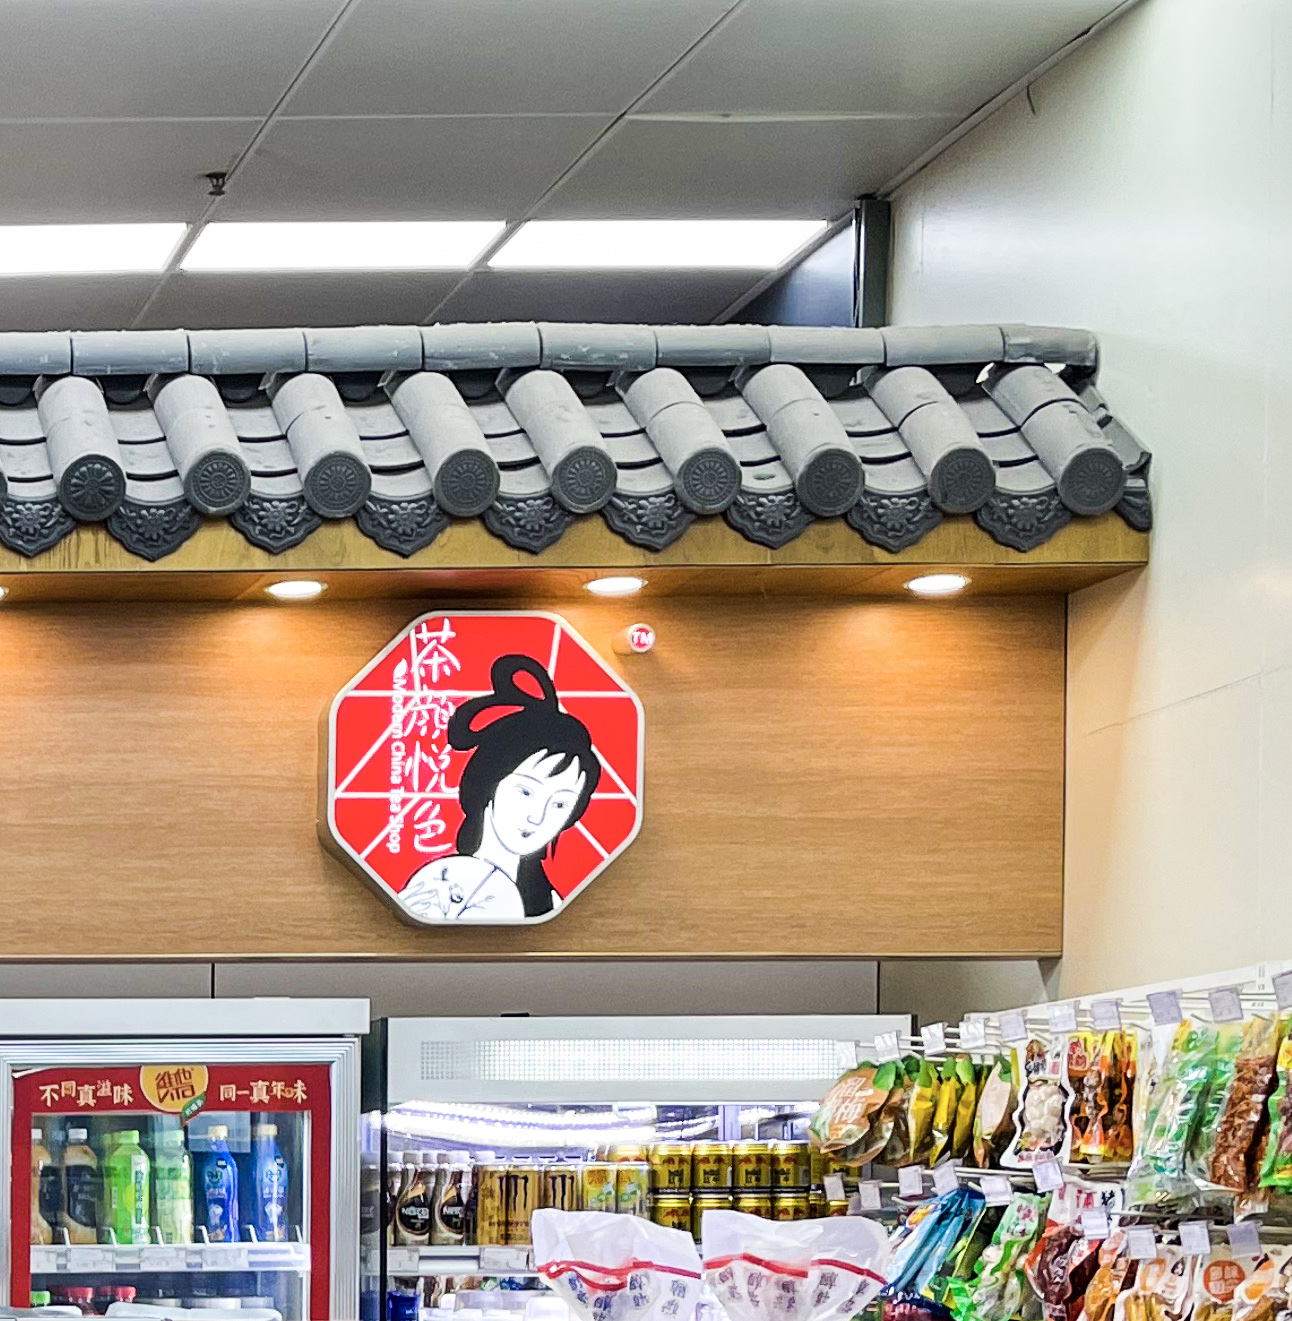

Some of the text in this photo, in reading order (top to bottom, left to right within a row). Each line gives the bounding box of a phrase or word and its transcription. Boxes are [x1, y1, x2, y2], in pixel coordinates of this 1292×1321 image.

[632, 632, 652, 644] TM
[386, 678, 406, 853] Modern China Tea Shop
[404, 618, 460, 852] 茶颜悦色
